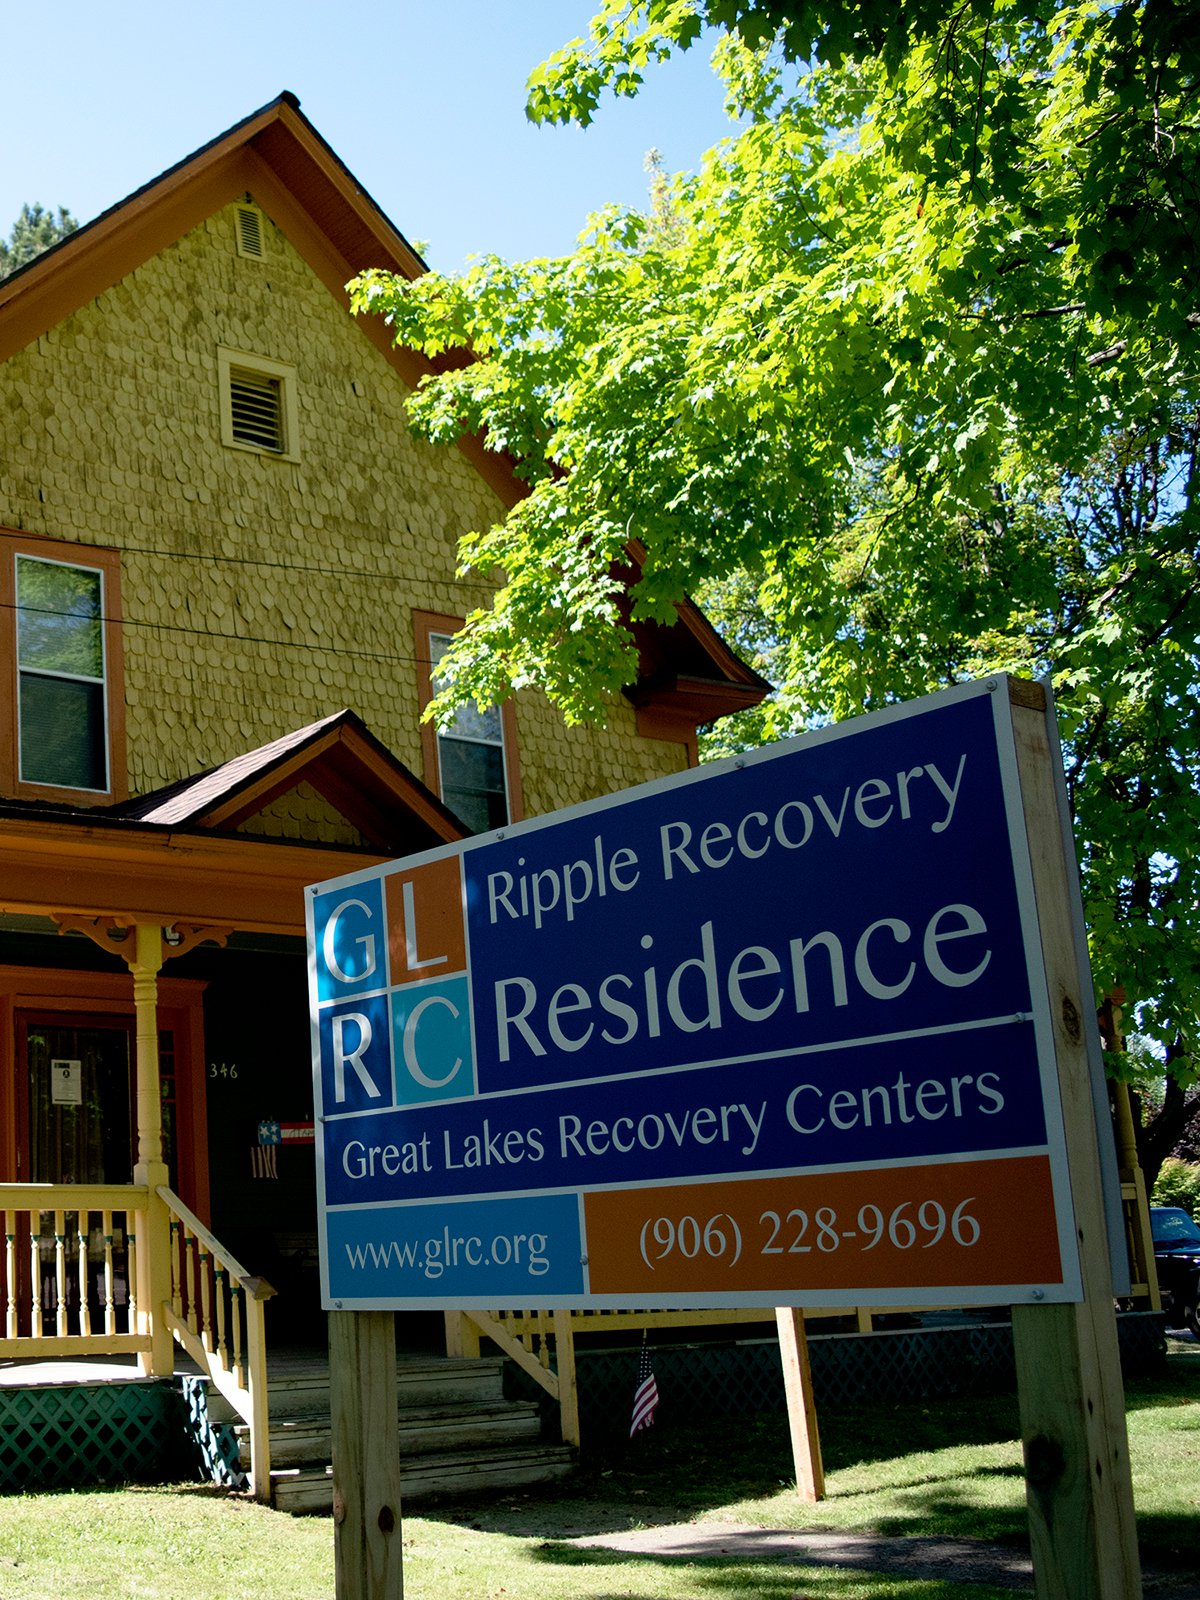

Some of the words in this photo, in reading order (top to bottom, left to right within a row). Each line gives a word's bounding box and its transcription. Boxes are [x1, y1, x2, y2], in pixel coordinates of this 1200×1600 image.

[487, 835, 641, 929] Ripple
[660, 754, 967, 880] Recovery
[494, 904, 992, 1062] Residence
[209, 1063, 238, 1079] 346
[342, 1131, 433, 1179] Great
[443, 1119, 545, 1170] Lakes
[559, 1101, 767, 1156] Recovery
[786, 1071, 1004, 1134] Centers
[345, 1225, 550, 1279] www.glrc.org
[639, 1214, 742, 1269] (906)
[759, 1198, 981, 1254] 228-9696
